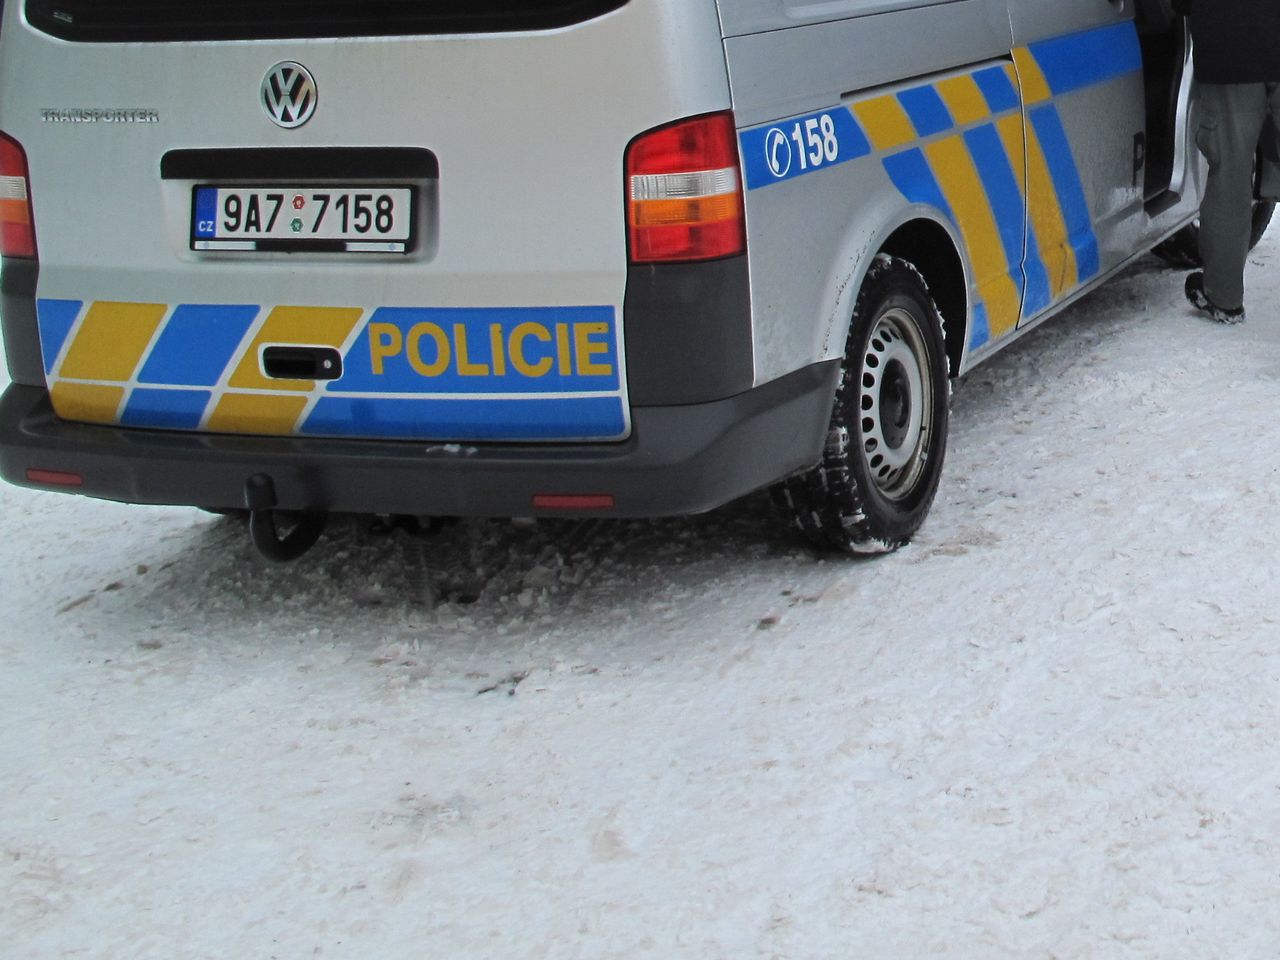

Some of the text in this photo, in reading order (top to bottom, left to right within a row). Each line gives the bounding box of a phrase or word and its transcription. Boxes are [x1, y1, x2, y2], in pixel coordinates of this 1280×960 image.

[40, 107, 160, 123] TRANSPORTER
[792, 114, 838, 169] 158
[198, 220, 214, 233] CZ
[223, 193, 395, 234] 9A7 7158
[367, 321, 613, 378] POLICIE
